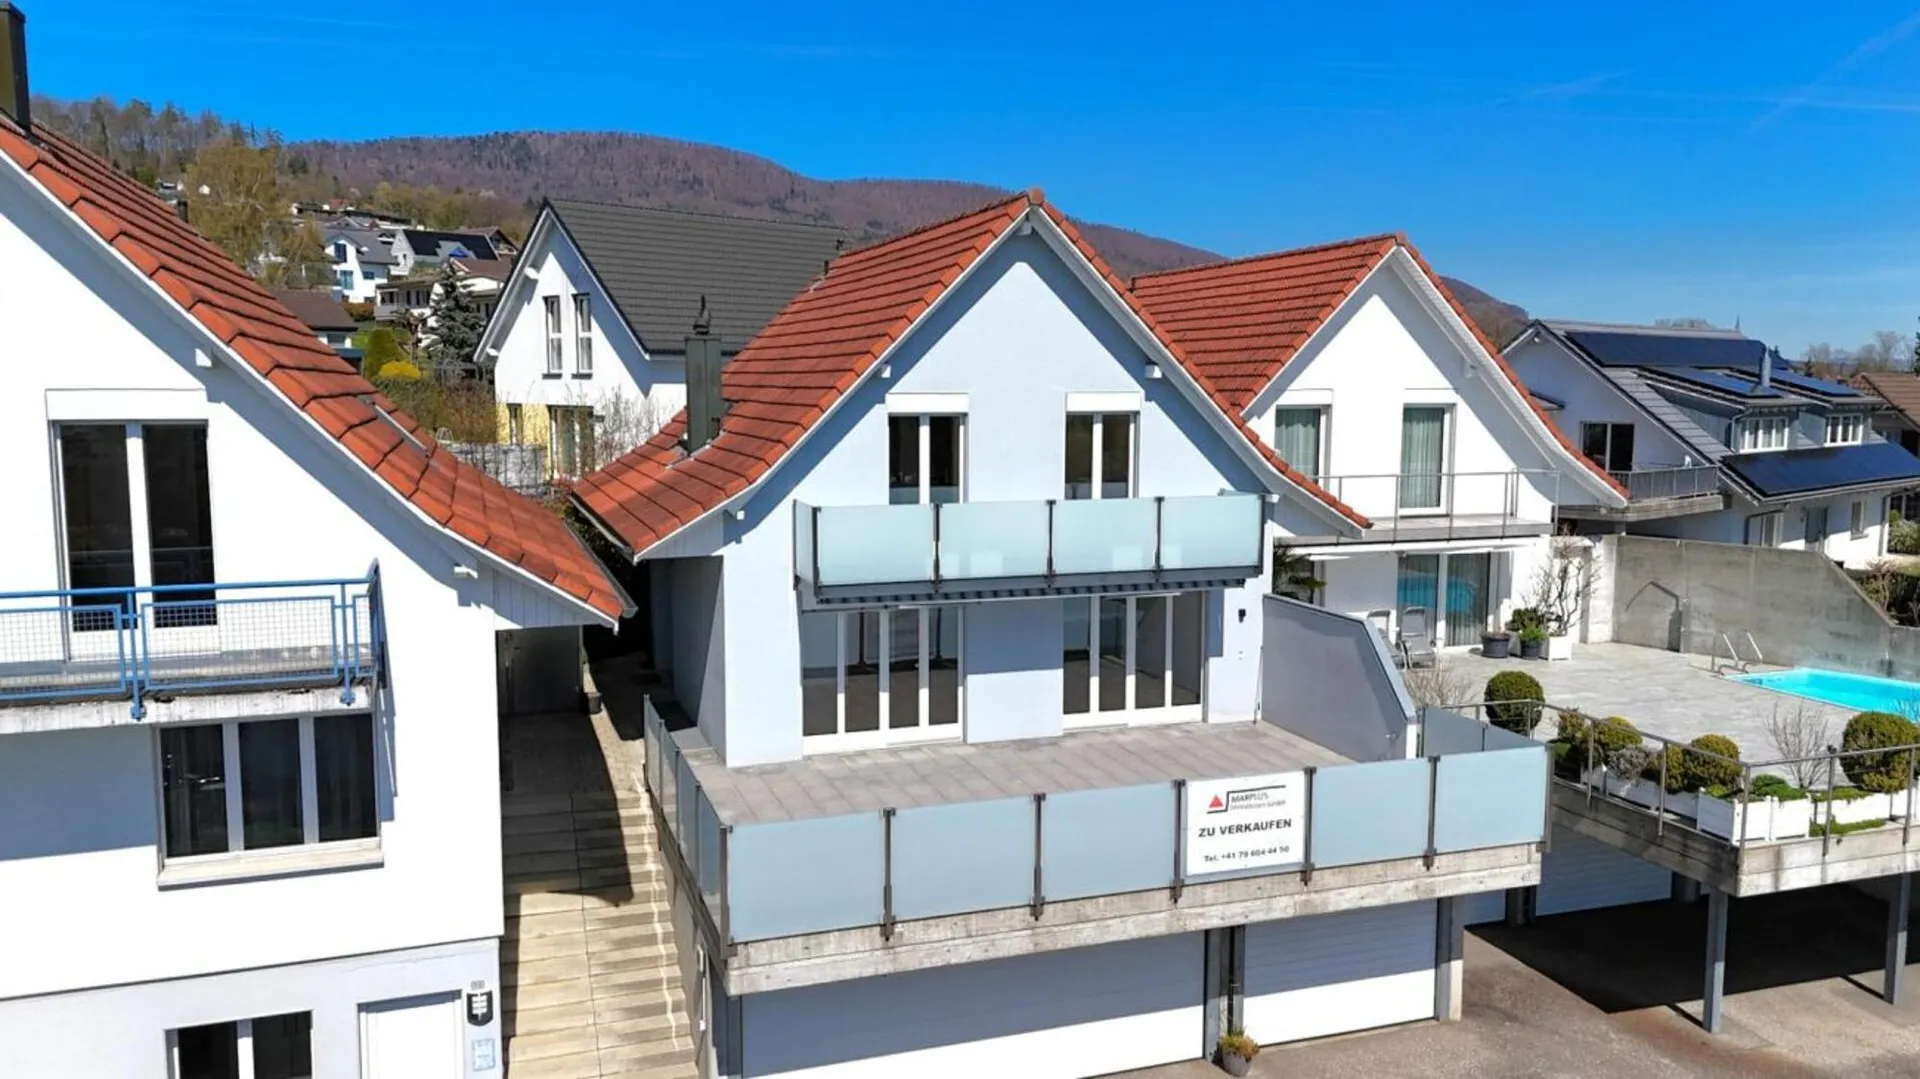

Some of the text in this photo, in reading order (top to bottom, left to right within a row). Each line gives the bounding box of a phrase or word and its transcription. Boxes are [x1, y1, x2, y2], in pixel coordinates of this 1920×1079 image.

[1231, 792, 1269, 803] MARPLUS
[1198, 818, 1292, 838] ZU VERKAUFEN
